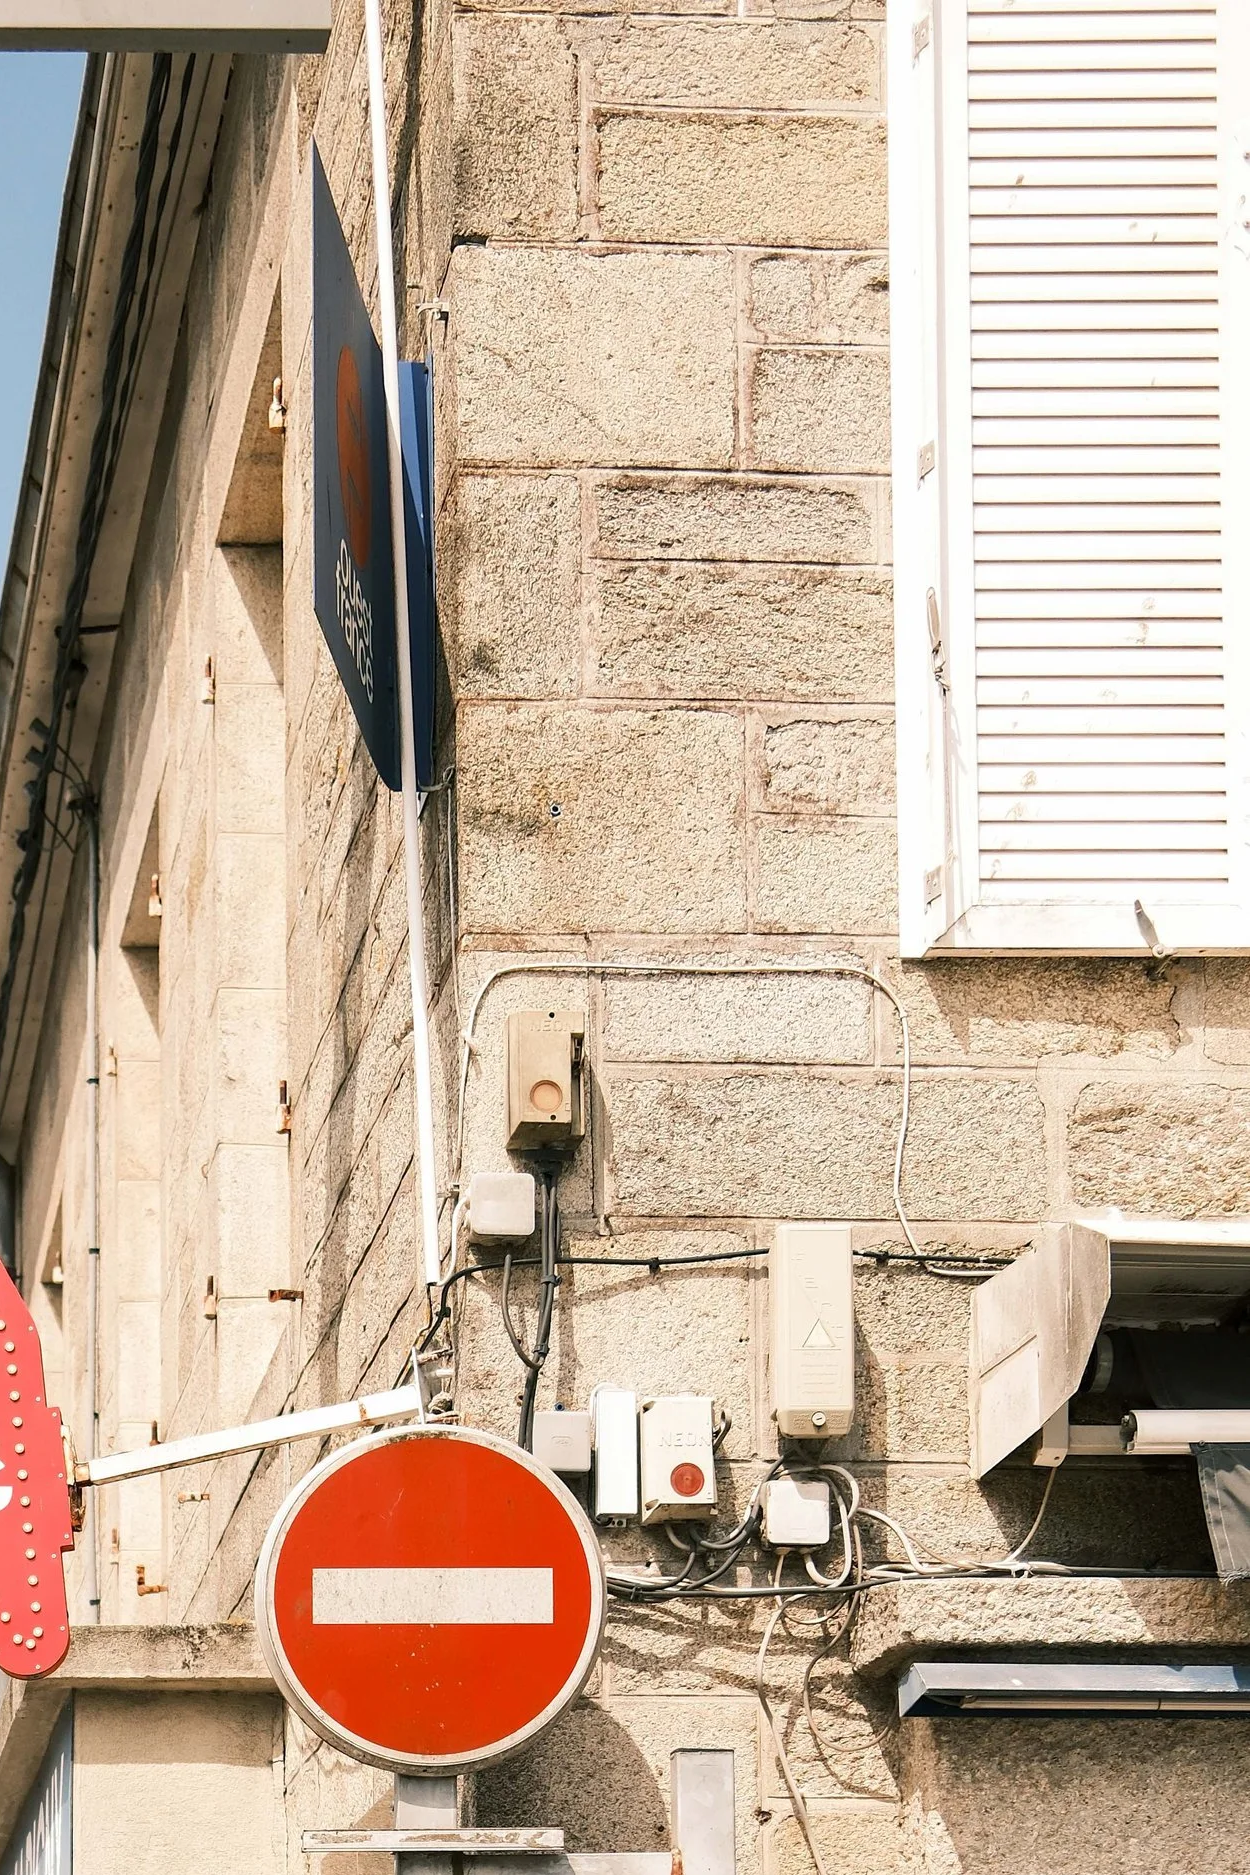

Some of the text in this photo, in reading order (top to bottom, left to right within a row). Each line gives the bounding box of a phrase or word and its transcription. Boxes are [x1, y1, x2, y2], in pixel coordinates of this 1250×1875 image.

[336, 559, 374, 704] france
[340, 538, 373, 660] ouest
[659, 1432, 712, 1447] NEON
